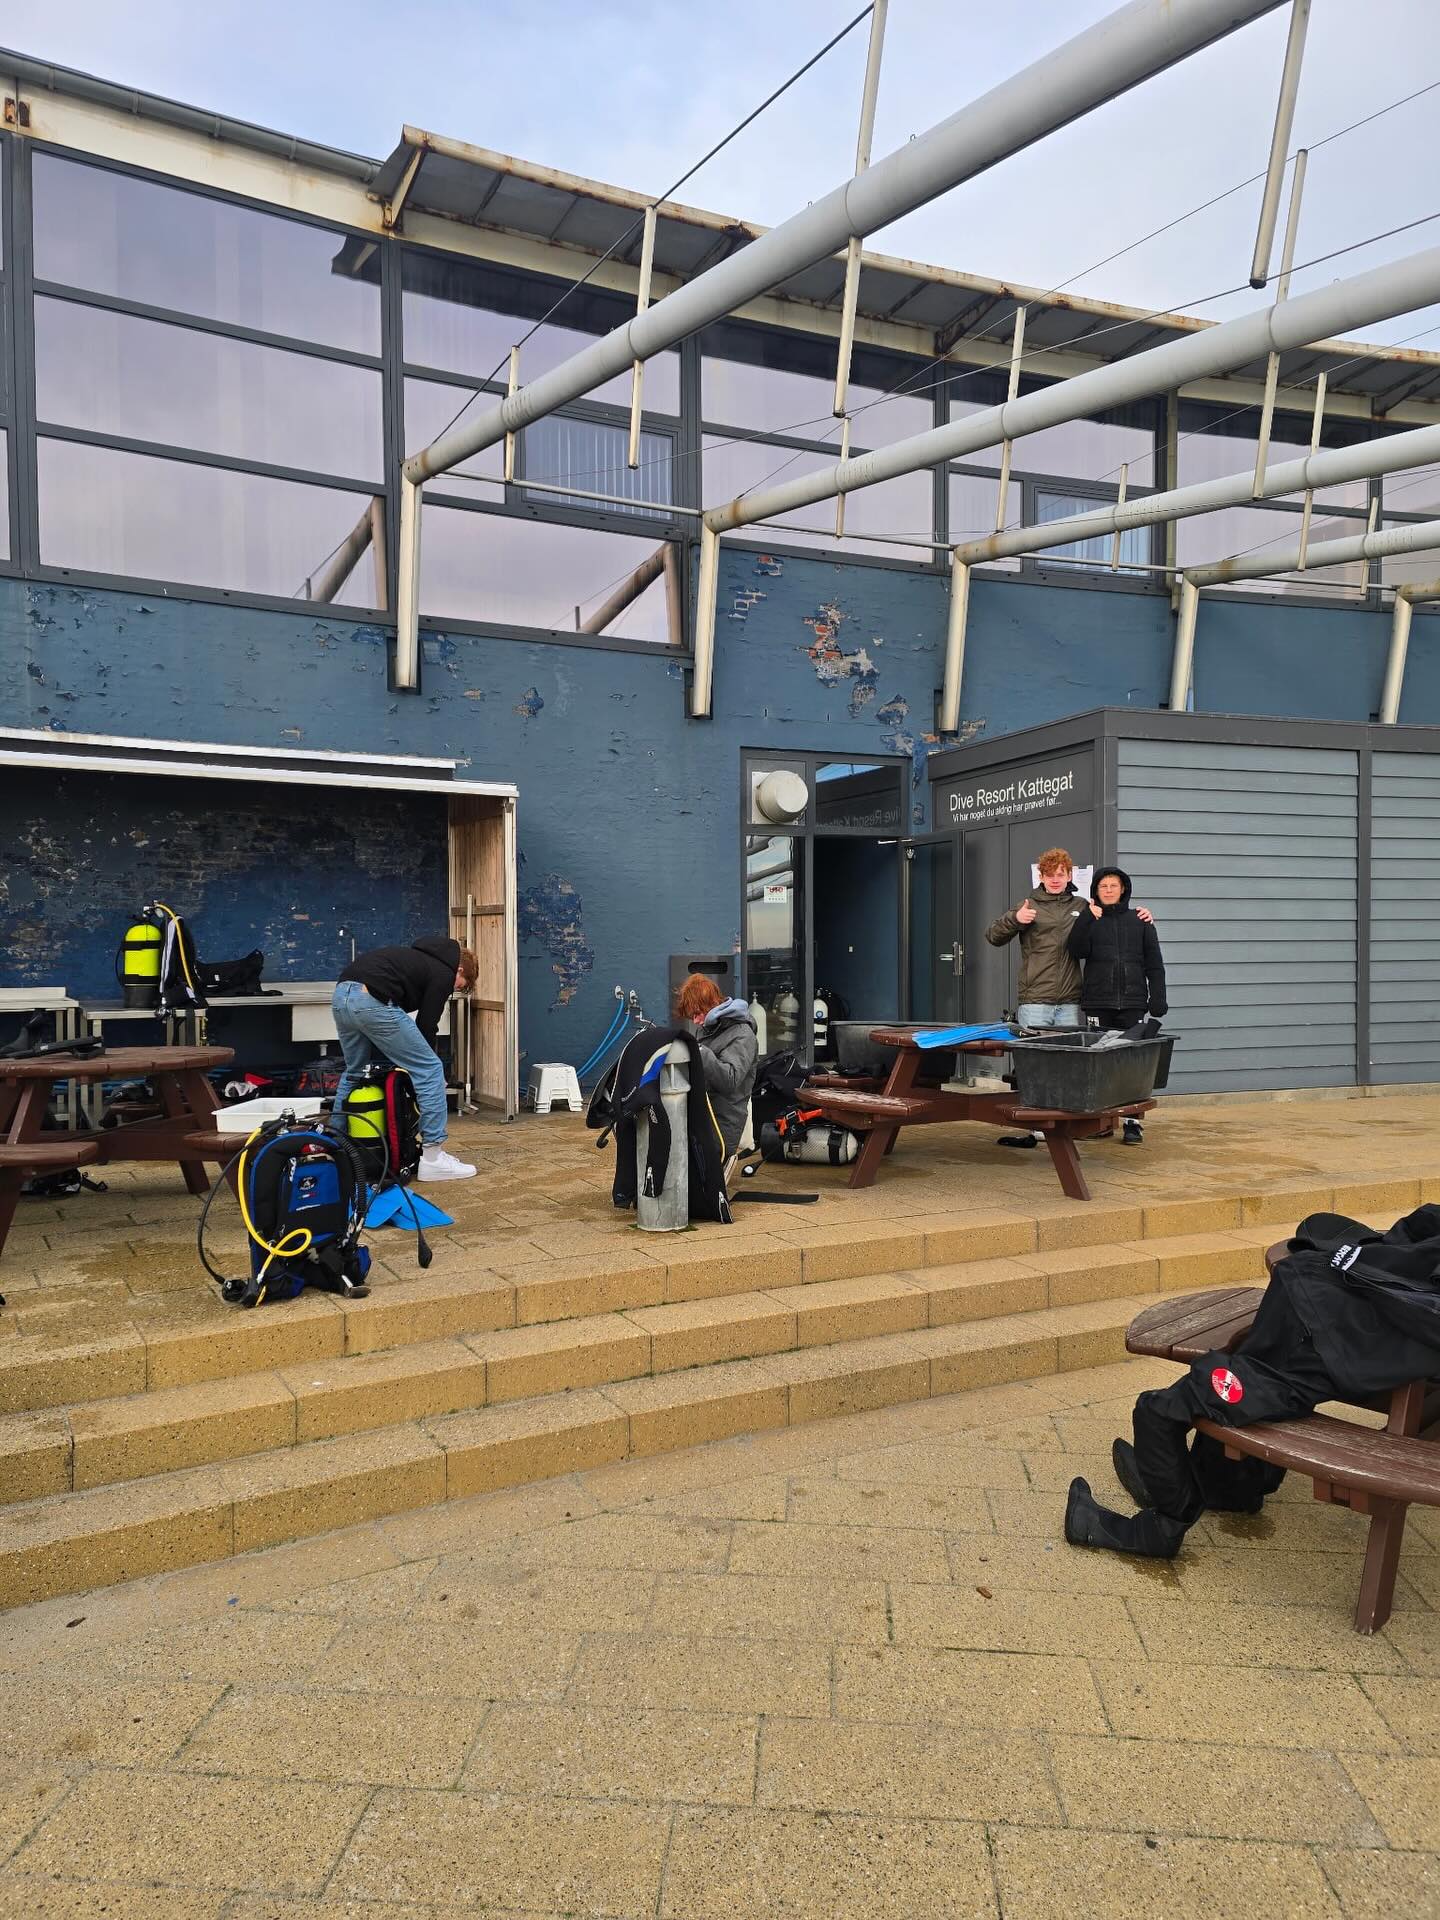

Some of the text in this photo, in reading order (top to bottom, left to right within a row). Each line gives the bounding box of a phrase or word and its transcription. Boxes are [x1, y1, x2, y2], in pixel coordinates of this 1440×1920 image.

[950, 770, 1073, 811] Dive Resort Kattegat
[952, 813, 959, 823] Vi
[960, 812, 969, 821] har
[969, 809, 986, 821] noget
[986, 807, 995, 817] du
[995, 804, 1012, 816] aldrig
[1012, 802, 1024, 812] har
[1024, 798, 1046, 813] prøvet
